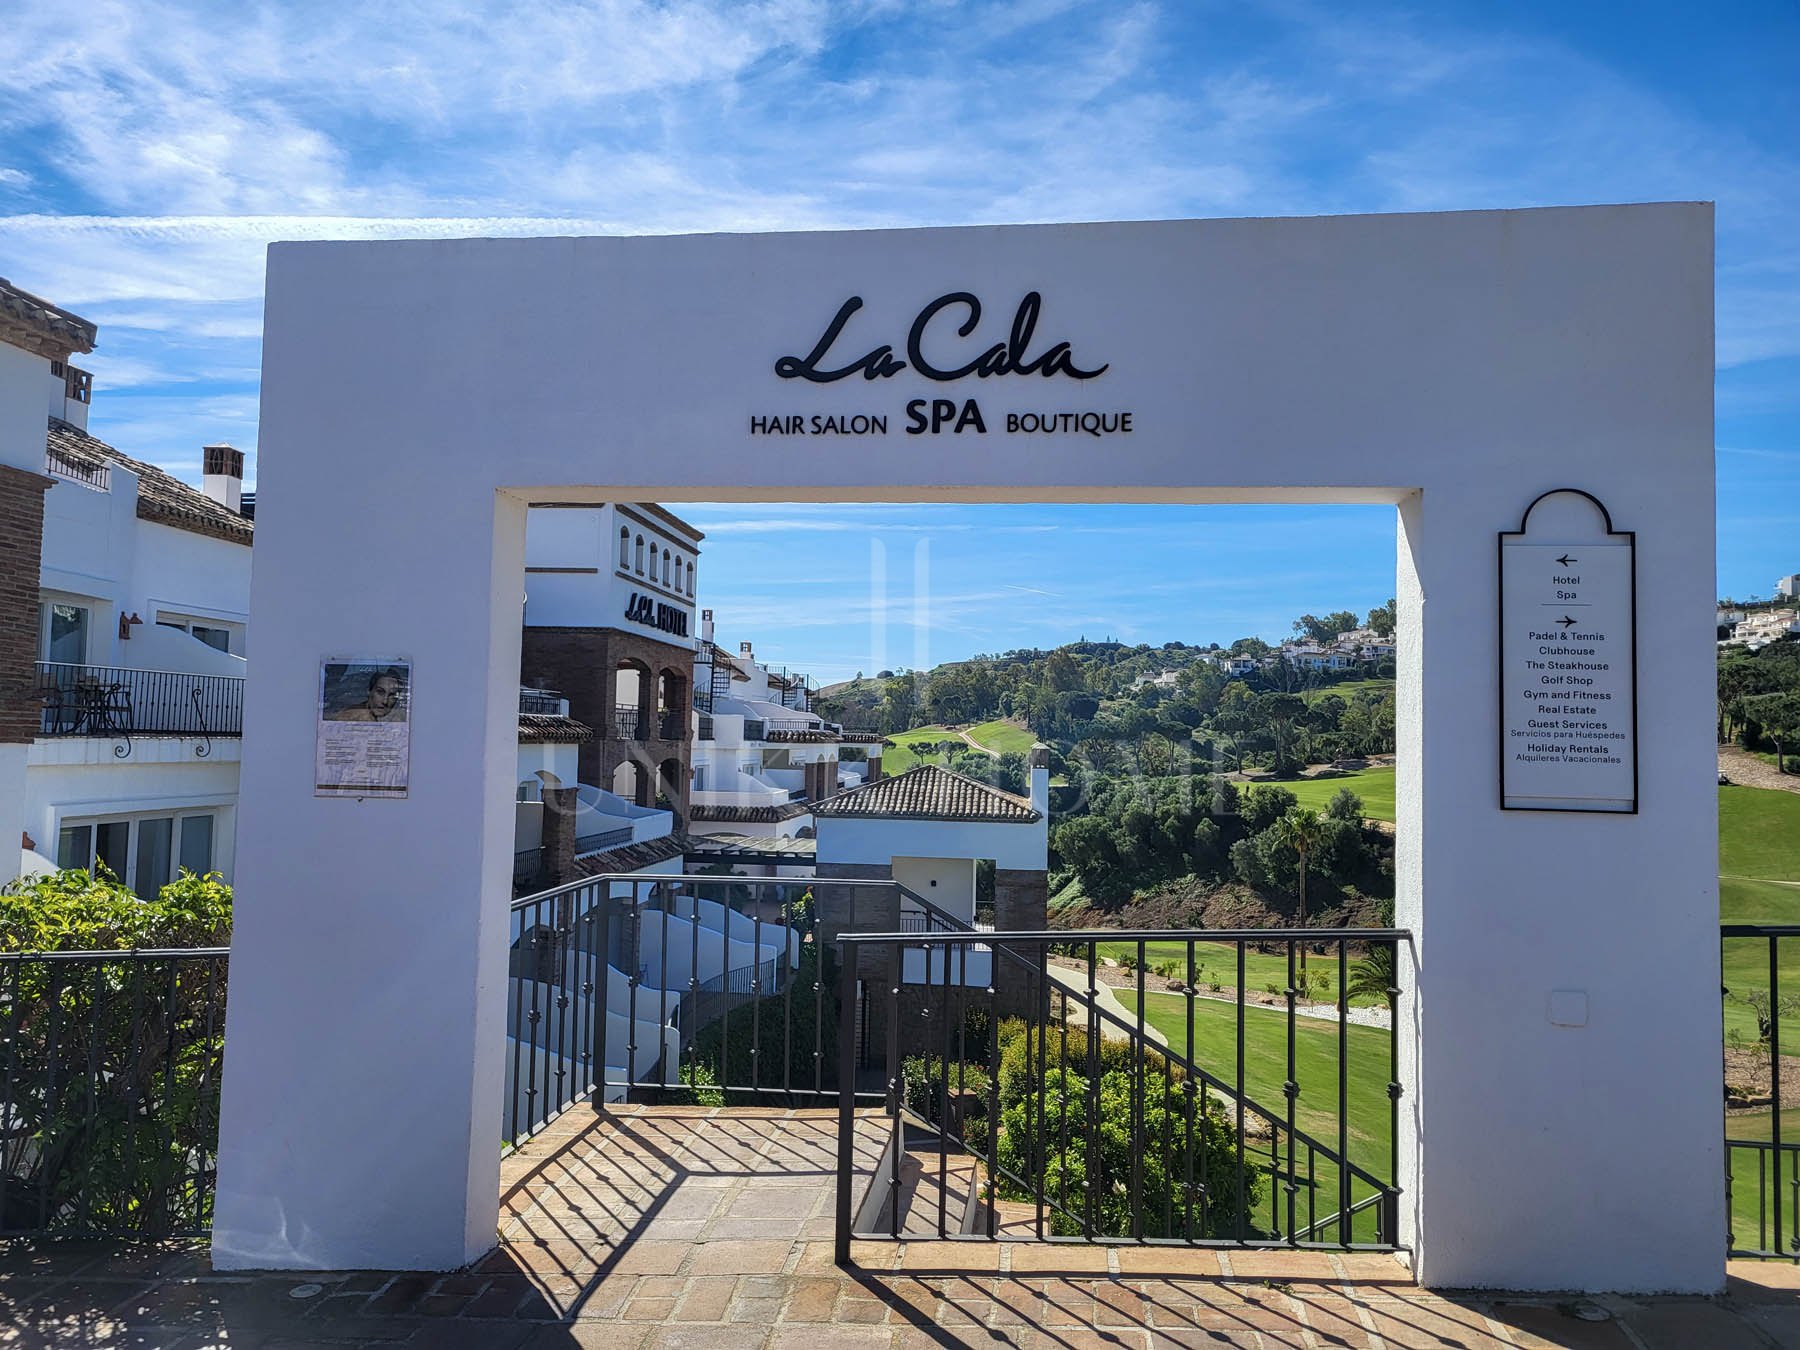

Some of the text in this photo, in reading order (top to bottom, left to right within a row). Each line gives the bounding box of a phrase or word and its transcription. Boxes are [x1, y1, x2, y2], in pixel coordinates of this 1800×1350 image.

[751, 399, 1133, 437] HAIR SALON SPA BOUTIQUE
[1553, 576, 1580, 584] Hotel
[1556, 590, 1577, 600] Spa
[1529, 632, 1605, 641] Padel & Tennis
[1539, 646, 1595, 655] Clubhouse
[1526, 661, 1609, 670] The Steakhouse
[1541, 676, 1593, 687] Golf Shop
[1523, 690, 1612, 700] Gym and Fitness
[1538, 705, 1597, 714] Real Estate
[1528, 720, 1608, 730] Guest Services
[1510, 730, 1551, 738] Servicios
[1527, 744, 1609, 754] Holiday Rentals
[1516, 754, 1622, 764] Alquileres Vacacionales
